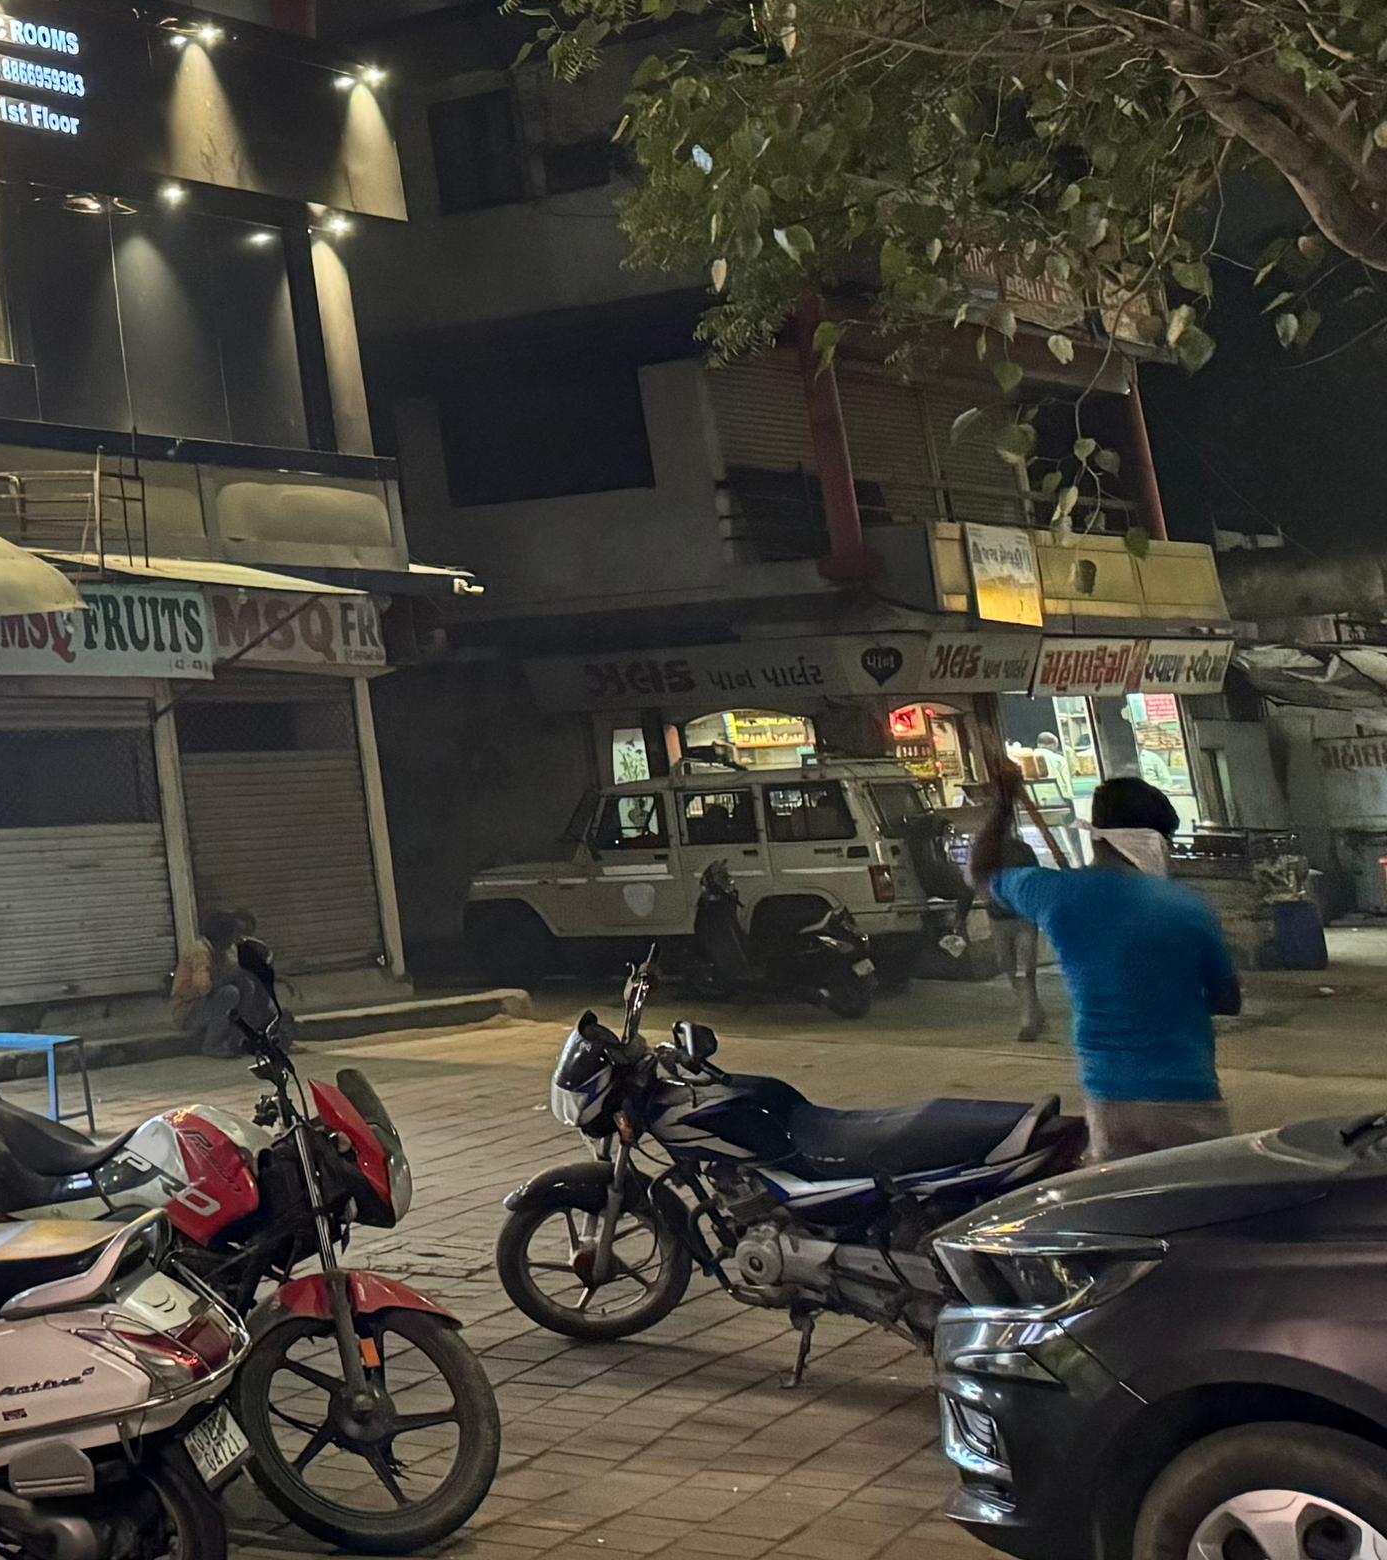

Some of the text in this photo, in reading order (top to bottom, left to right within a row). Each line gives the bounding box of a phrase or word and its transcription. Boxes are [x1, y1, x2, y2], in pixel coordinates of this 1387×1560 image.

[9, 18, 80, 55] ROOMS
[1, 57, 85, 98] 8866959383
[29, 103, 80, 135] Floor
[0, 594, 204, 664] MSQ FRUITS
[213, 595, 337, 662] MSQ
[708, 666, 753, 691] પાન
[763, 655, 824, 687] પાર્લર
